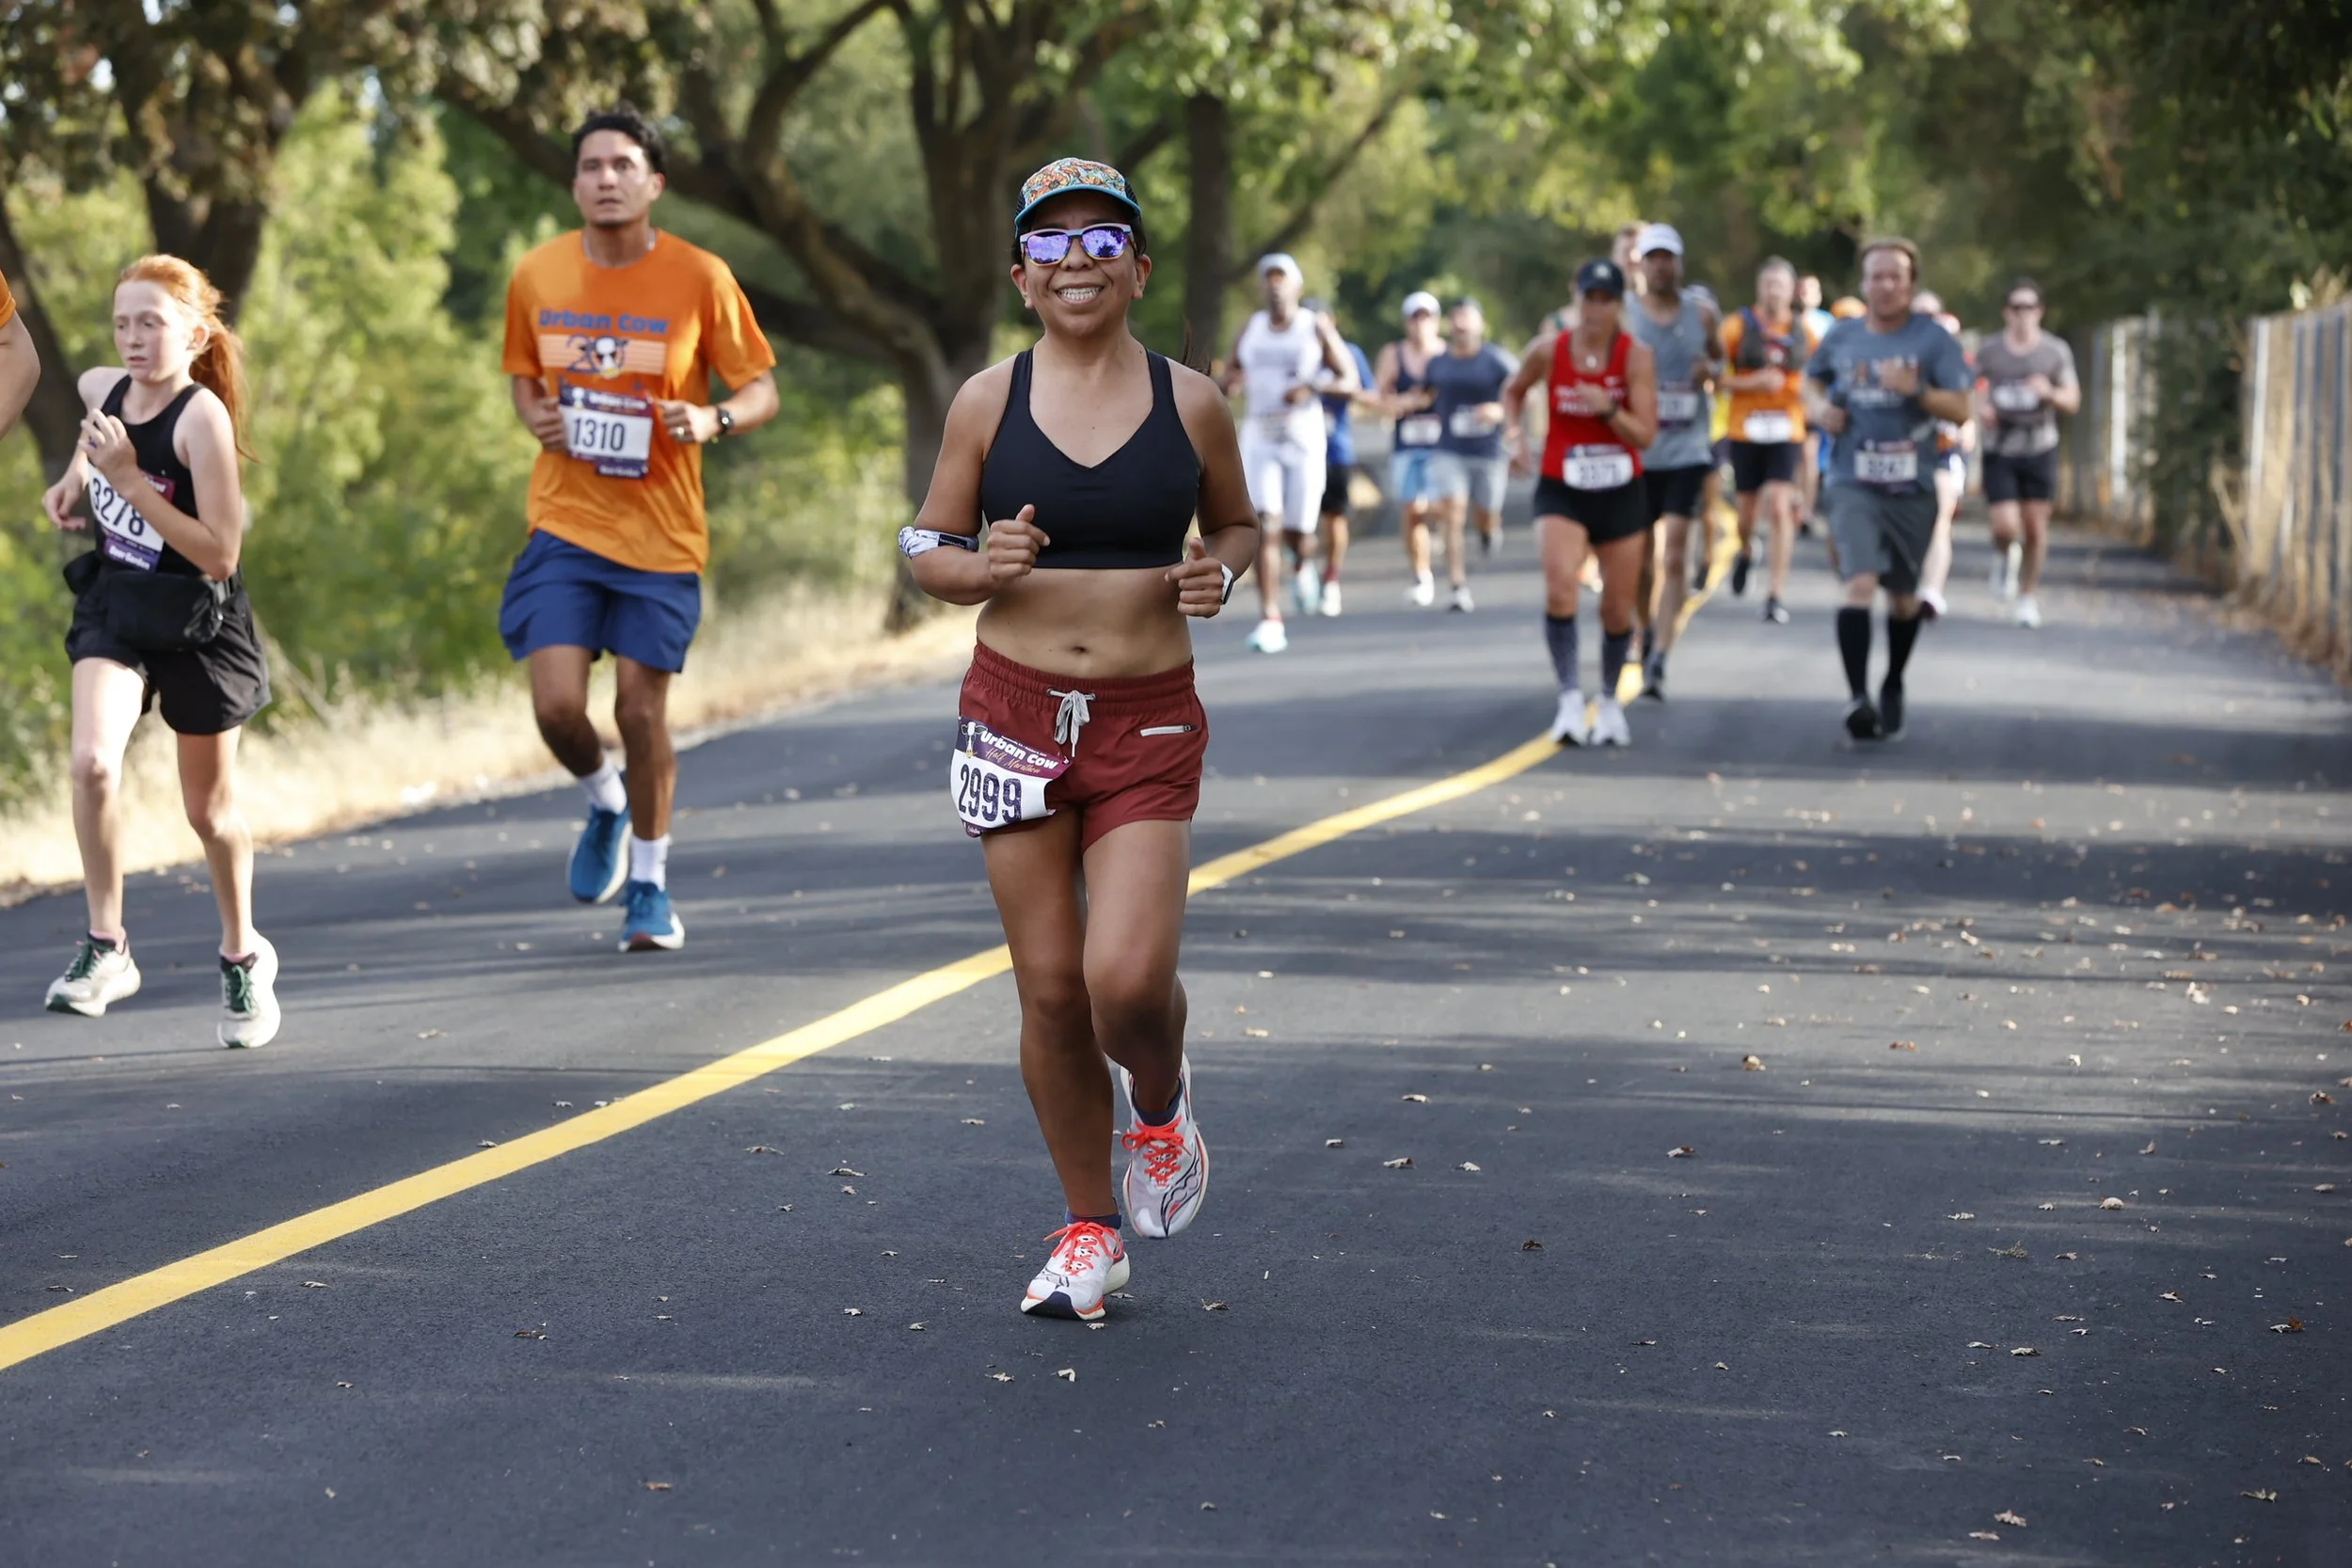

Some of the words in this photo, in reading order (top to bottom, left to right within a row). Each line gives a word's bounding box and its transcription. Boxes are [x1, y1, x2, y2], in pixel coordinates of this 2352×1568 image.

[539, 309, 611, 328] Urban
[617, 313, 669, 334] Cow
[573, 418, 626, 452] 1310
[92, 478, 145, 536] 3278
[980, 731, 1026, 760] Urban
[1026, 753, 1059, 769] Cow
[985, 747, 1008, 763] Half
[1005, 758, 1041, 773] Marathon
[958, 763, 1023, 824] 2999
